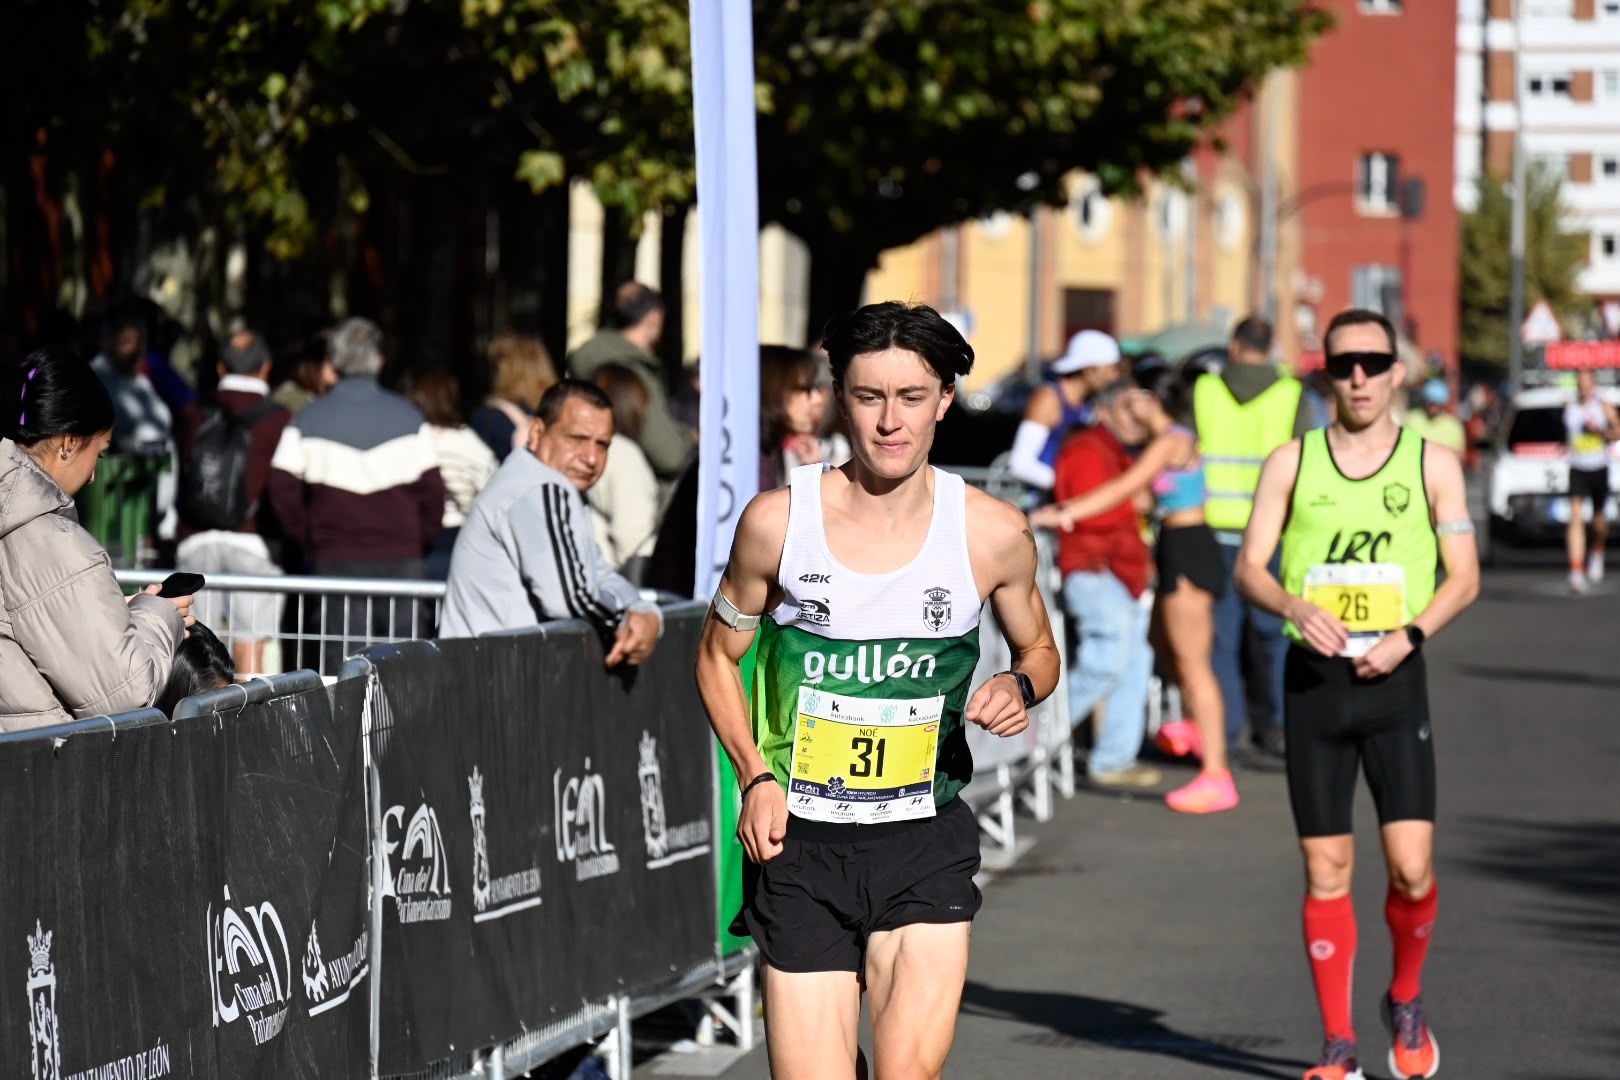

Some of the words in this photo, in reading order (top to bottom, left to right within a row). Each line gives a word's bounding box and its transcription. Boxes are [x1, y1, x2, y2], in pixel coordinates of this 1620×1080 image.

[1325, 530, 1392, 563] LRC
[799, 574, 831, 584] 42K
[1339, 592, 1368, 622] 26
[802, 643, 936, 684] gullón
[850, 737, 886, 778] 31
[234, 983, 264, 1012] Cuna
[258, 972, 275, 1004] del
[148, 1036, 170, 1079] LEÓN
